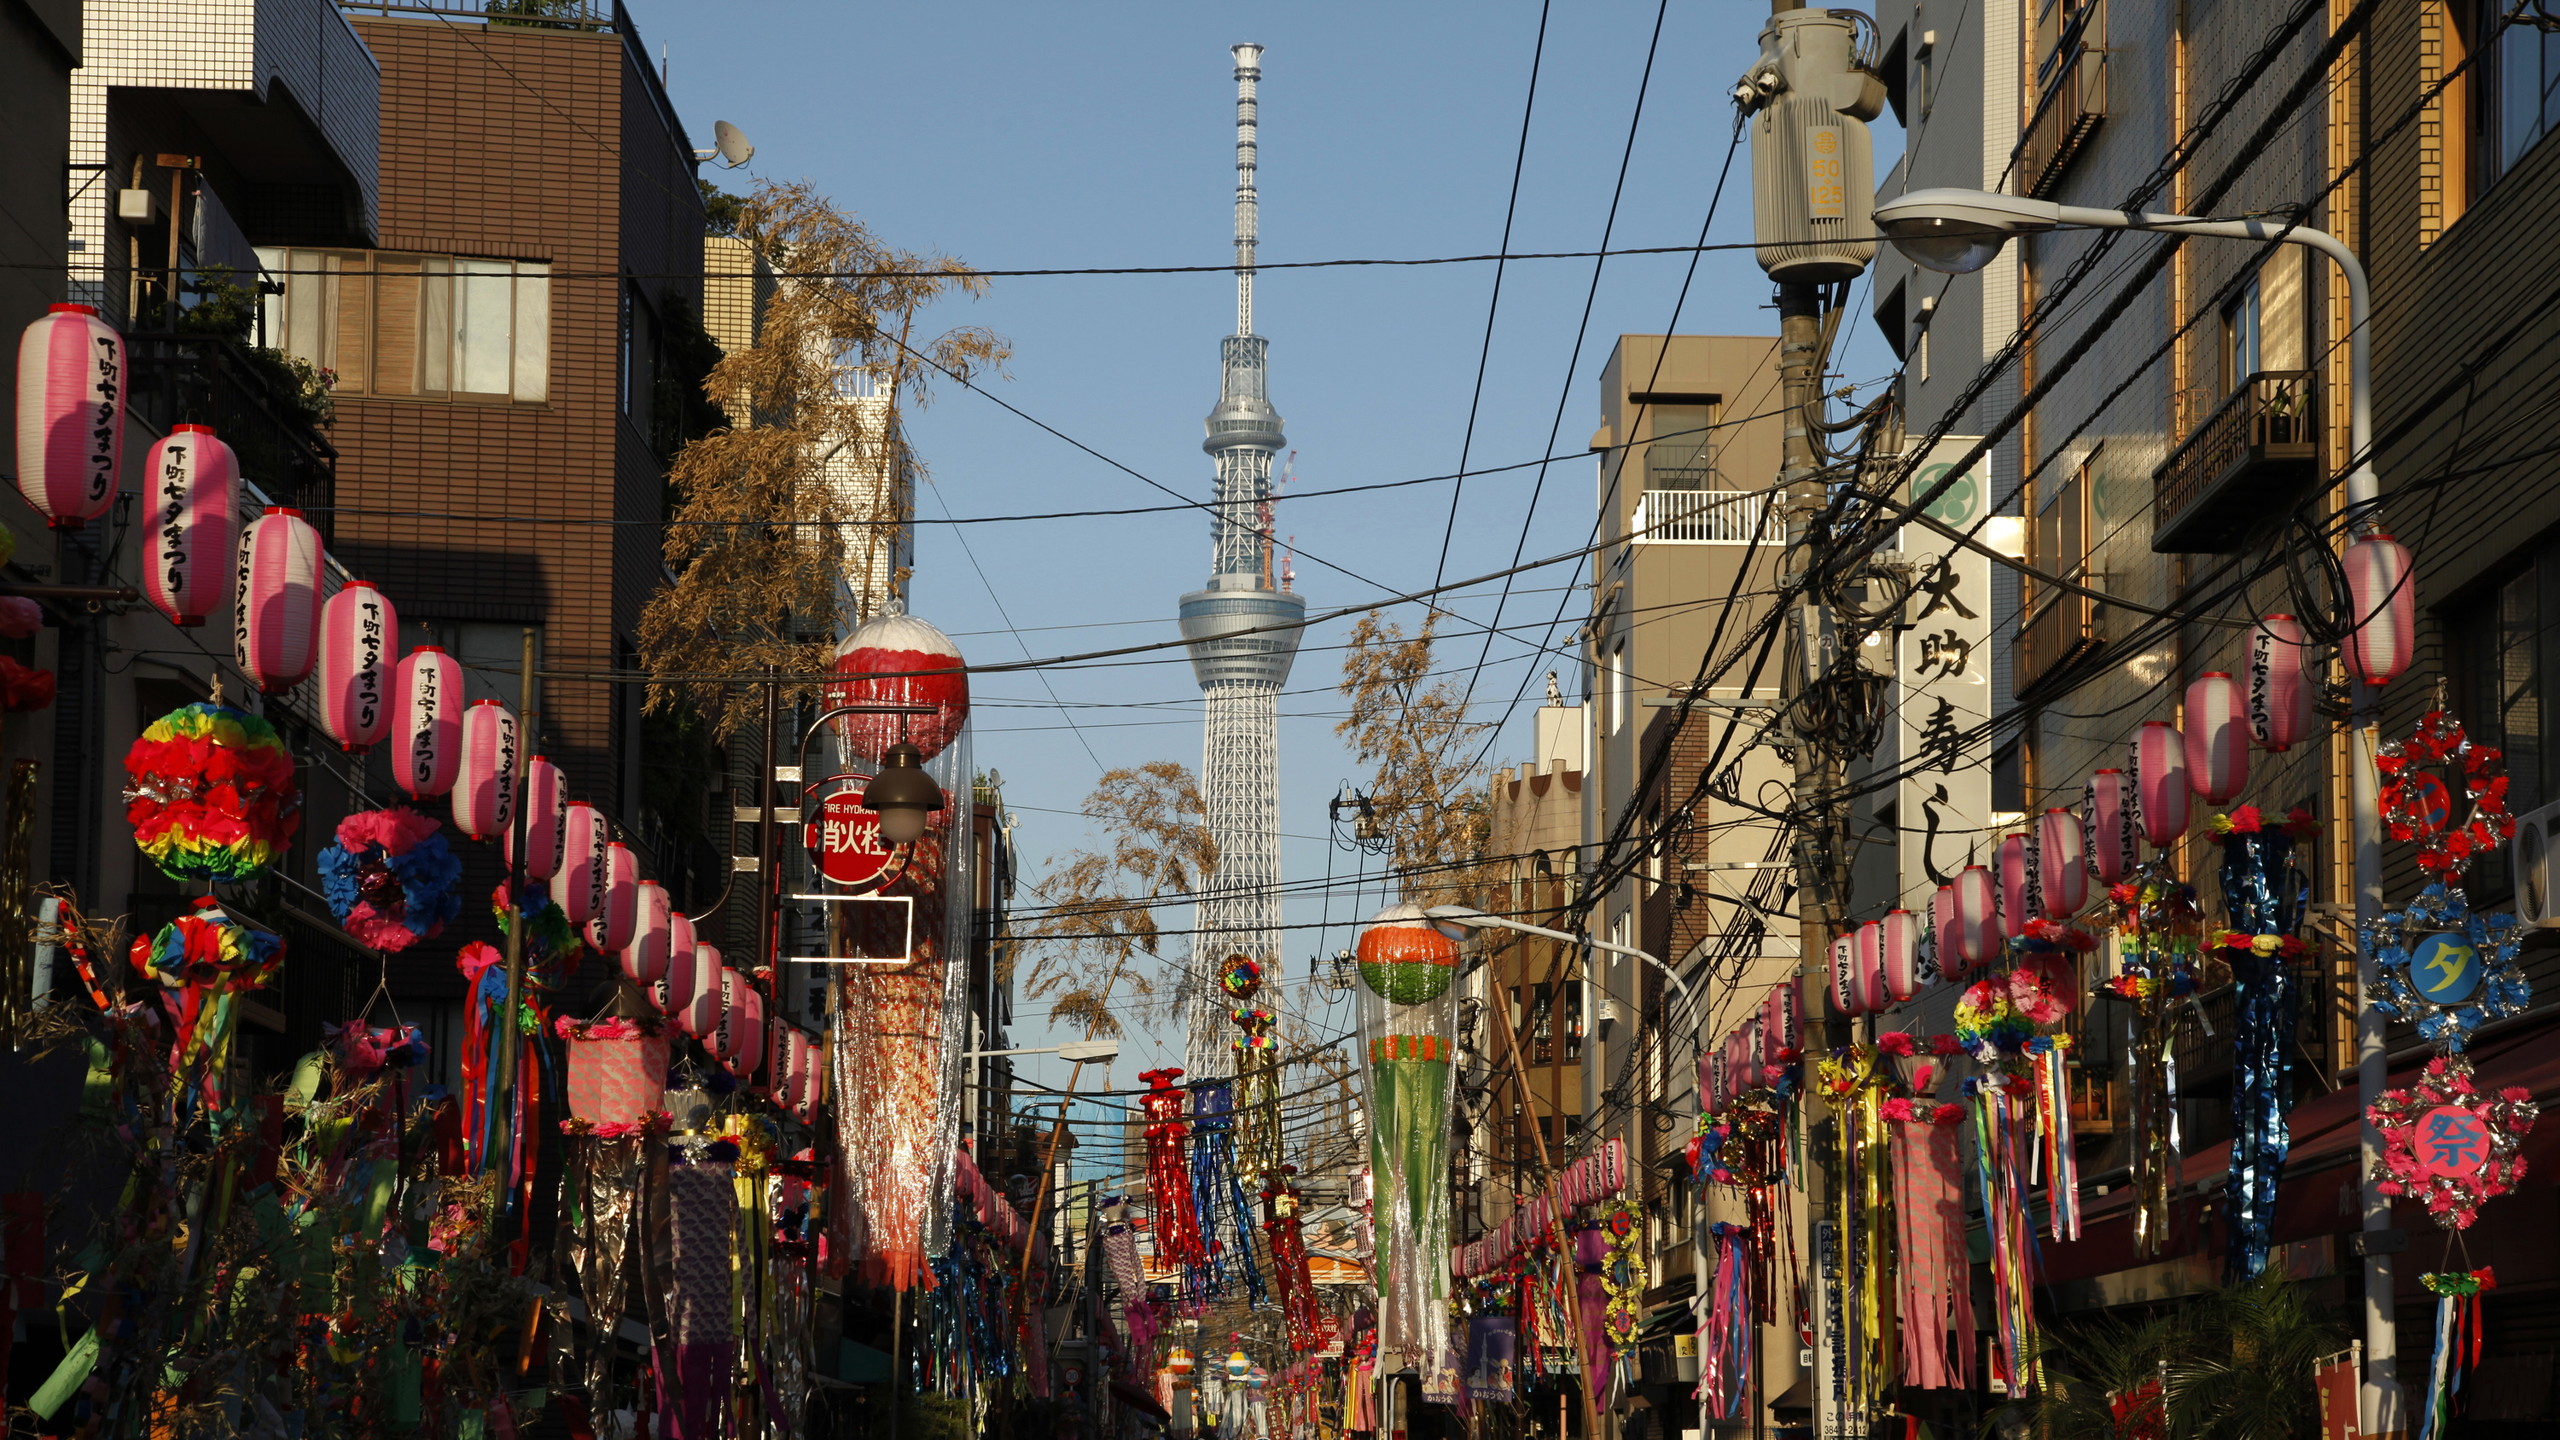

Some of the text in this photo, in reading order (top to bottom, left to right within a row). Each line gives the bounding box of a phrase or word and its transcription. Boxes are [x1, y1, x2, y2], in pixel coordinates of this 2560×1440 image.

[1810, 186, 1844, 205] 125
[1812, 159, 1840, 178] 50
[88, 337, 118, 502] 下町七夕まつり
[163, 445, 188, 594] 下町七夕まつり
[235, 530, 252, 667] 下町七夕まつり
[360, 602, 381, 730] 下町七夕まつり
[2249, 634, 2271, 743] 下町七夕まつり
[416, 667, 436, 783] 下町七夕まつり
[497, 718, 515, 823] 下町七夕まつり
[823, 803, 841, 814] FIRE
[2084, 785, 2100, 876] キクヤ薬局
[2129, 741, 2145, 837] 下町七夕まつり
[591, 818, 605, 910] 下町七夕まつり
[814, 820, 887, 855] 消火栓
[1838, 945, 1851, 1009] 下町七夕まつり
[2426, 1113, 2483, 1167] 祭
